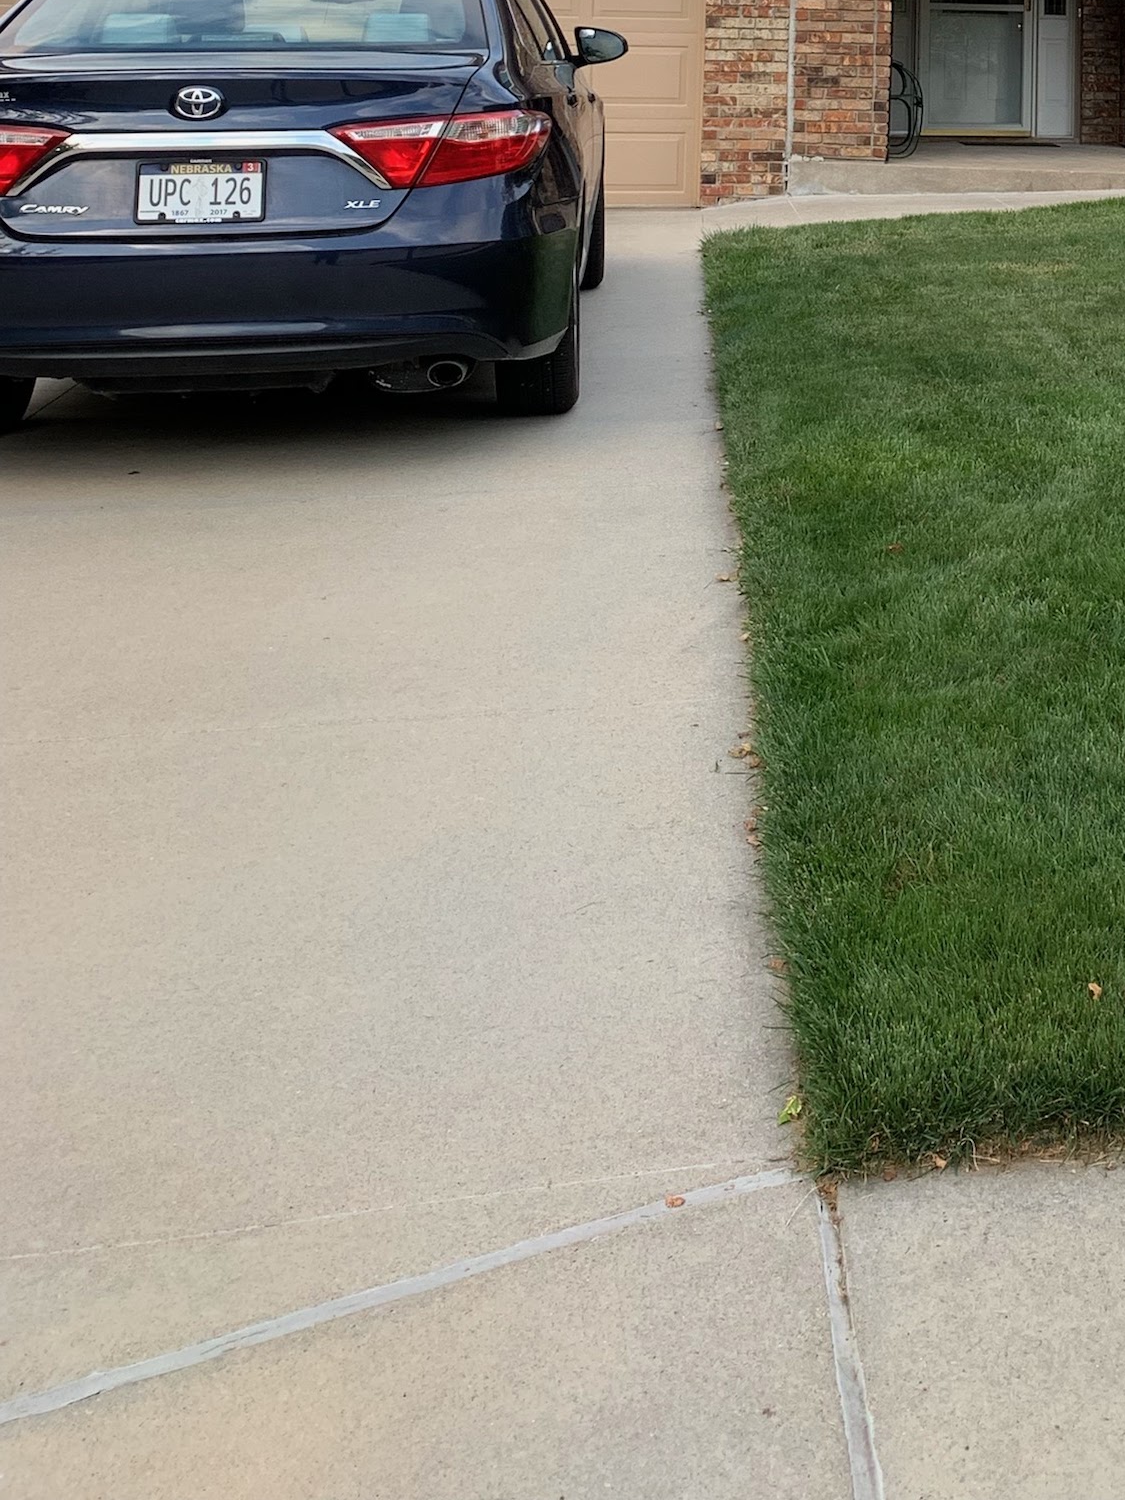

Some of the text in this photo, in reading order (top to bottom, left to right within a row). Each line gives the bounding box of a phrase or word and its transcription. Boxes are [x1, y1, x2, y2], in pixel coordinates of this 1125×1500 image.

[170, 164, 233, 174] NEBRASKA
[247, 163, 254, 171] 3
[149, 177, 252, 207] UPC 126
[20, 204, 89, 215] CAMRY
[343, 200, 381, 209] XLE
